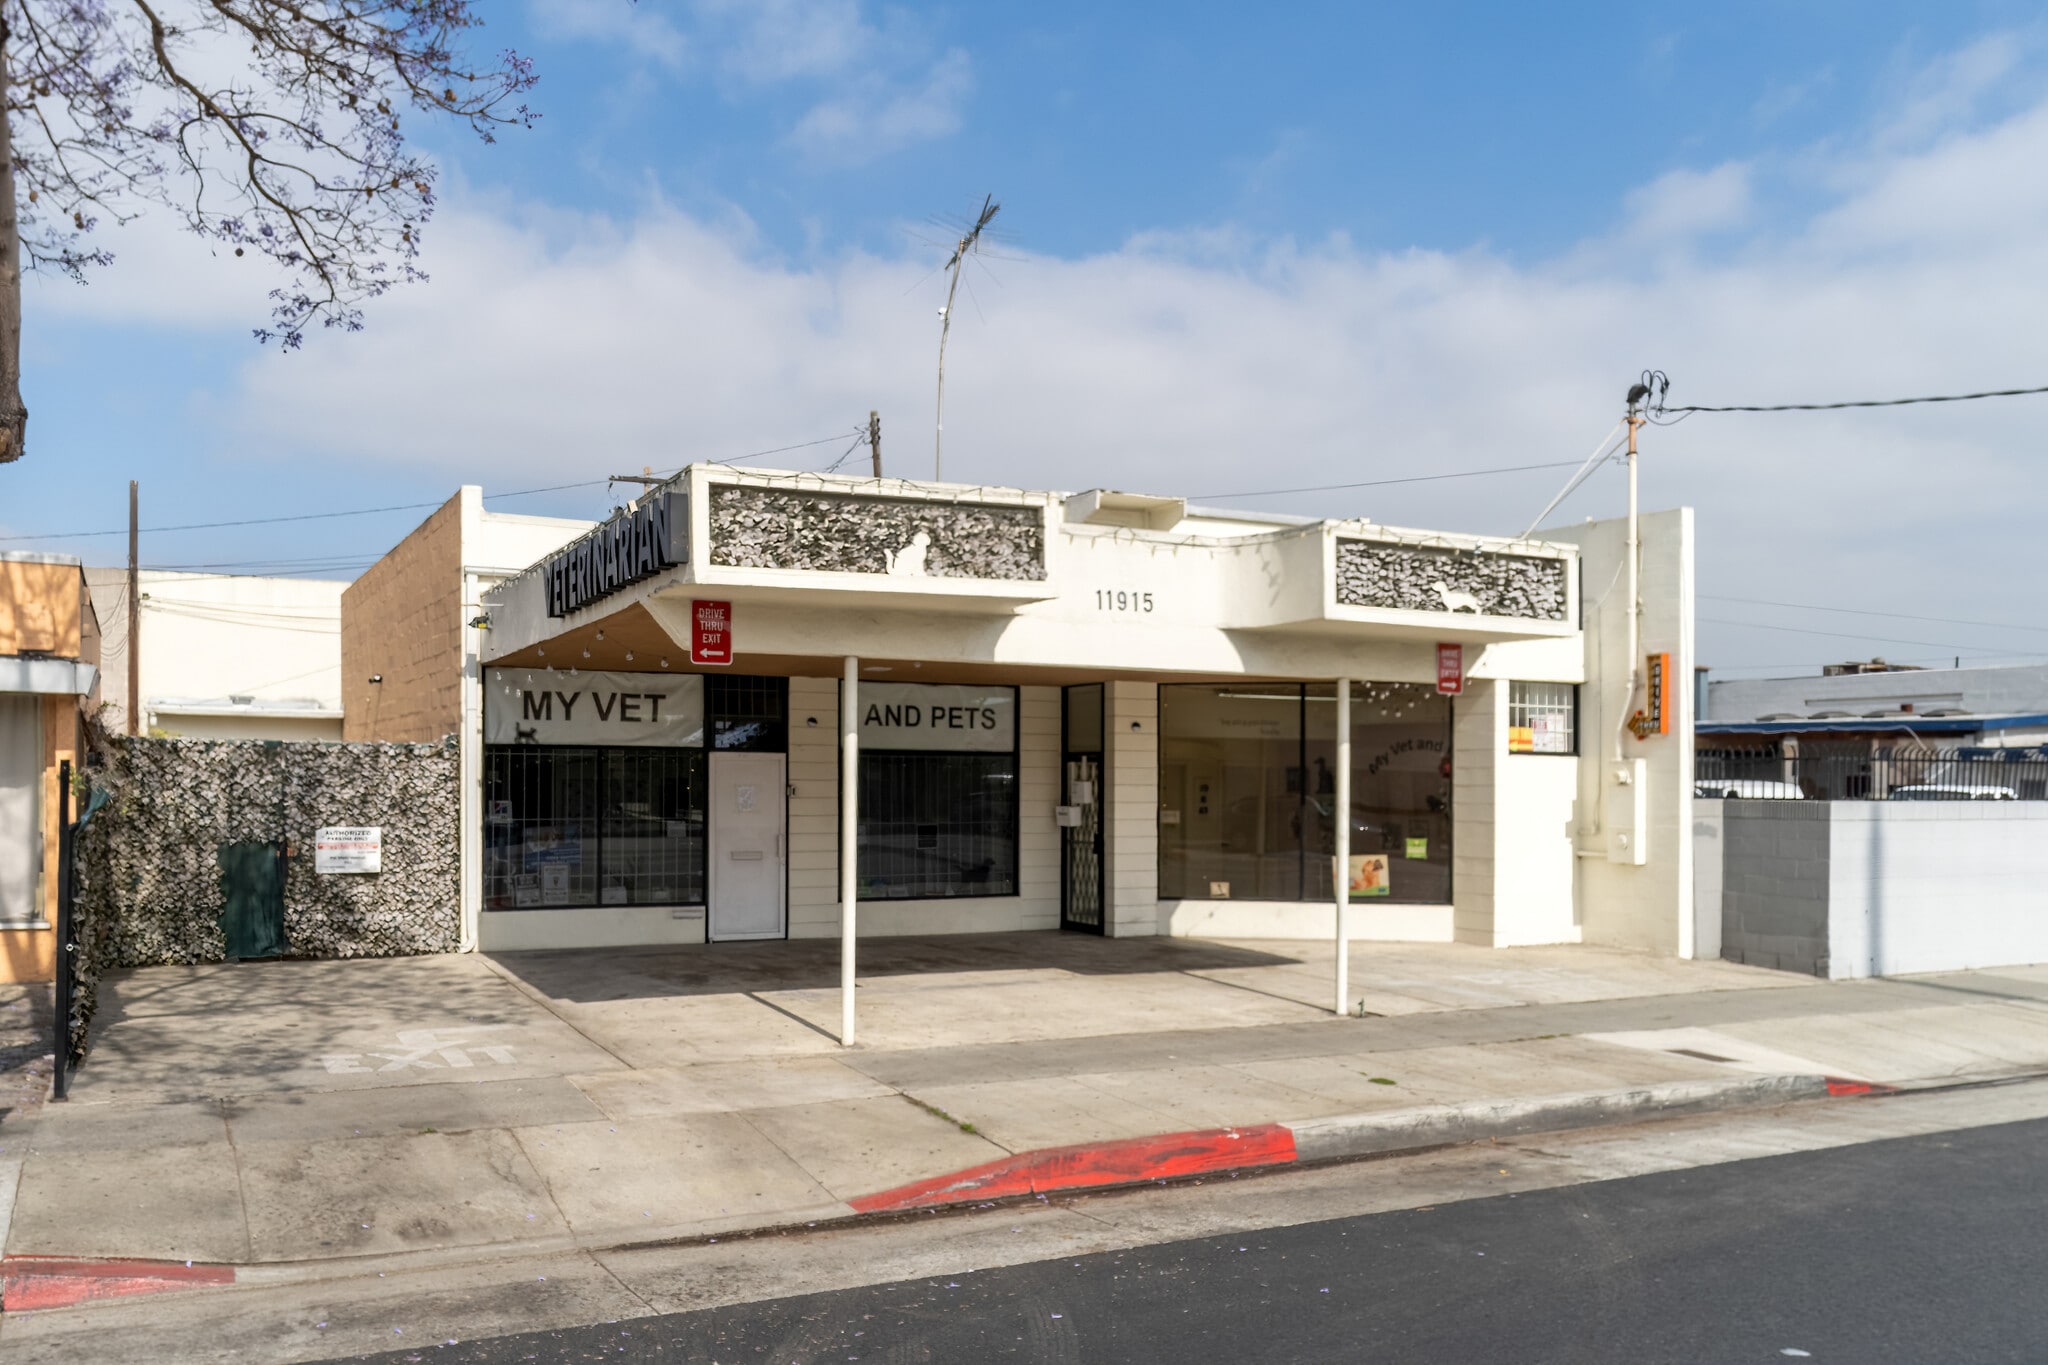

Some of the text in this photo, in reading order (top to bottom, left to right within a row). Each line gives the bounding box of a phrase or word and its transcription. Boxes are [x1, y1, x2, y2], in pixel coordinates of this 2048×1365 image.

[543, 493, 679, 617] VETERINARIAN
[698, 608, 725, 619] DRIVE
[1096, 590, 1153, 612] 11915
[700, 620, 724, 631] THRU
[702, 633, 721, 644] EXIT
[1653, 664, 1661, 719] DRIVE
[523, 690, 666, 723] MY VET
[864, 703, 996, 730] AND PETS
[1369, 739, 1443, 775] My Vet and
[320, 1044, 517, 1074] EXIT
